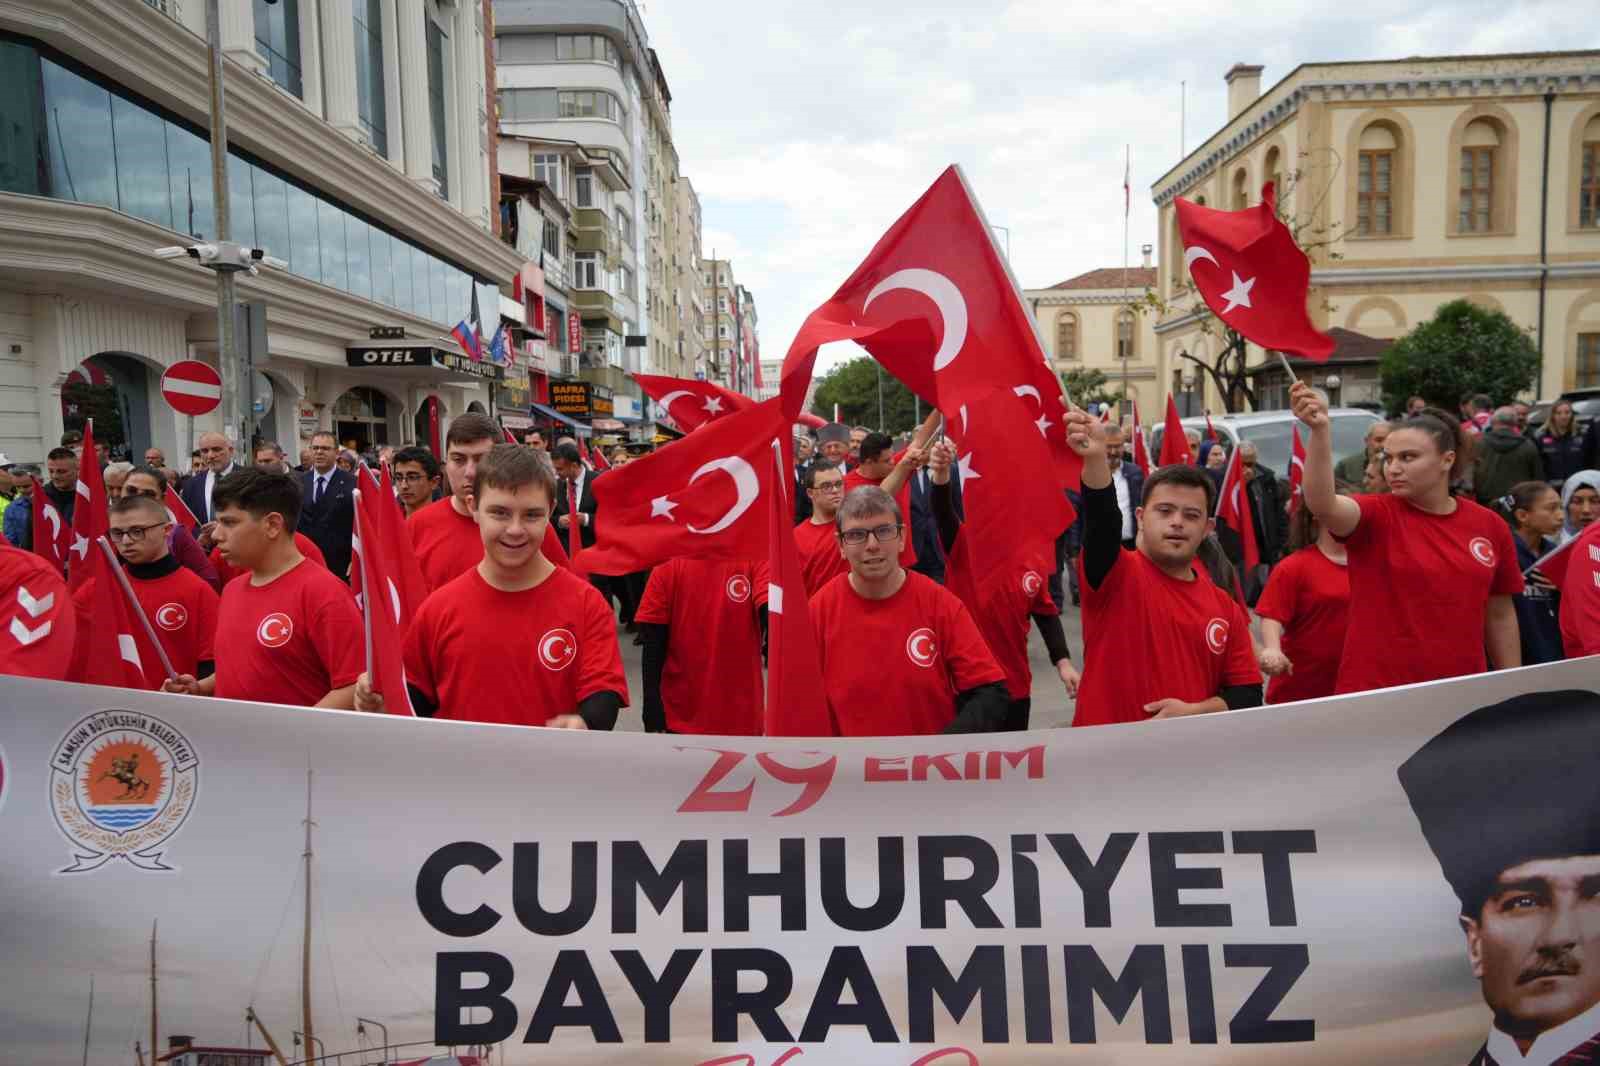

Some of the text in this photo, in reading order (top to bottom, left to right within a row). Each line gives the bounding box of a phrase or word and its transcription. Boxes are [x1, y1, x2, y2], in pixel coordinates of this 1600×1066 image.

[363, 351, 414, 363] OTEL
[57, 727, 90, 766] SAMSUN
[415, 829, 1318, 938] CUMHURİYET
[434, 943, 1316, 1047] BAYRAMIMIZ
